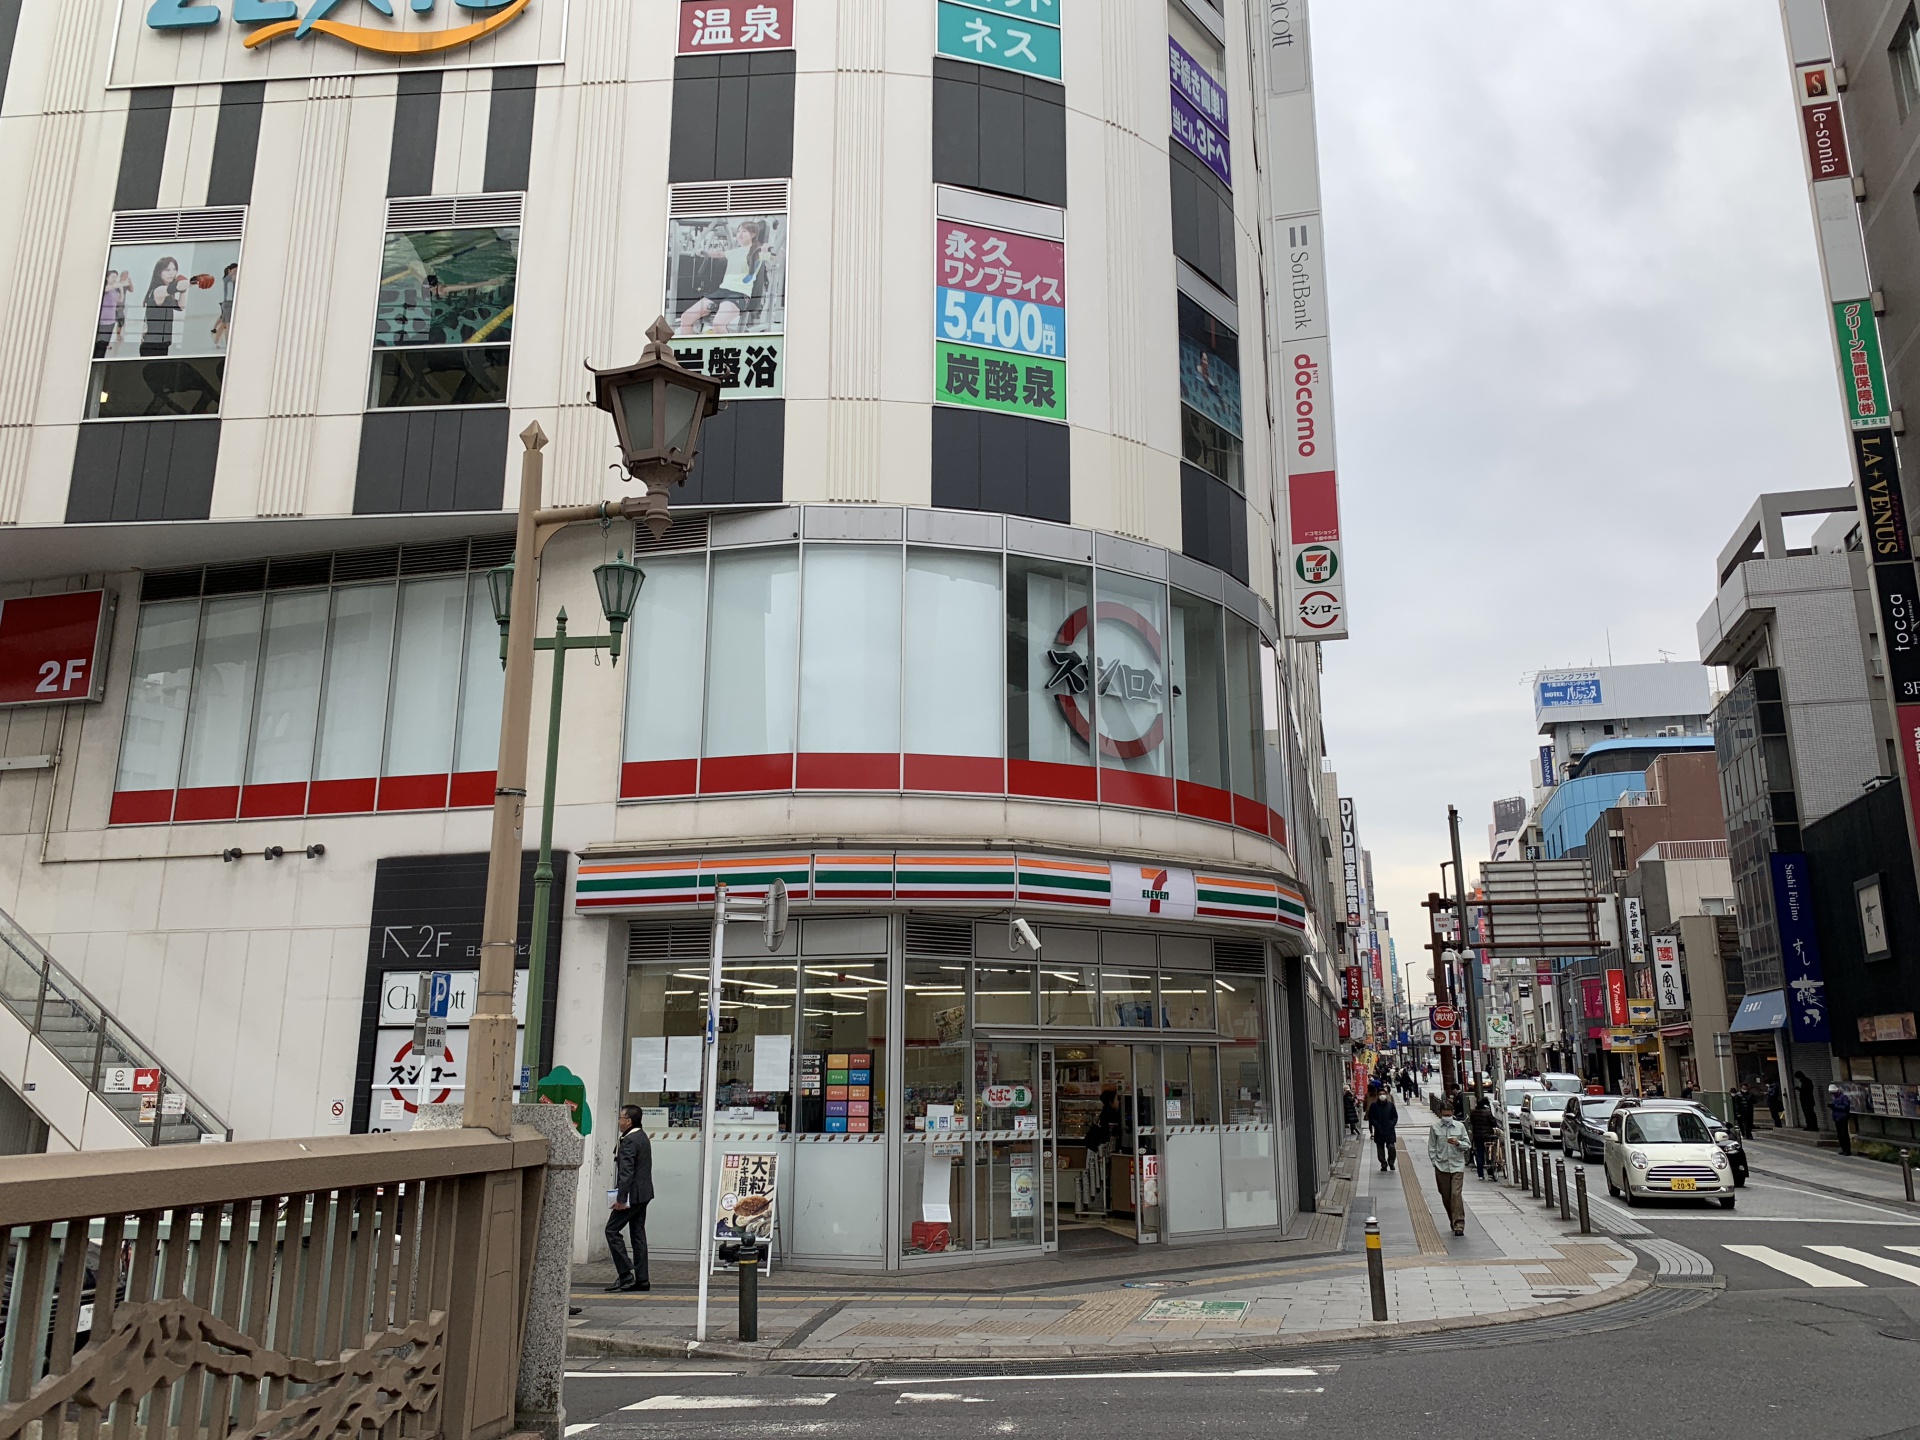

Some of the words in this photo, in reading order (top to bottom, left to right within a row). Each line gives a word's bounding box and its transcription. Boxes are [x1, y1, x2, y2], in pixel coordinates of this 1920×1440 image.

[691, 4, 782, 47] 温泉
[962, 18, 1038, 62] ネス
[1811, 74, 1822, 94] S
[1172, 105, 1229, 175] 当ビル3Fへ
[1812, 106, 1838, 174] le-sonia
[945, 230, 1012, 266] 永久
[944, 262, 1062, 304] ワンプライス
[1290, 252, 1313, 329] SoftBank
[945, 352, 1057, 409] 炭酸泉
[1294, 353, 1318, 457] docomo
[1861, 436, 1884, 468] LA
[1304, 528, 1337, 538] ドコモショップ
[1868, 479, 1898, 554] VENUS
[1298, 603, 1342, 616] スシロー
[1890, 593, 1911, 652] tocca
[35, 659, 87, 693] 2F
[1785, 863, 1797, 888] Sushi
[1788, 891, 1800, 921] Fujino
[416, 925, 452, 958] 2F
[434, 976, 448, 1013] P
[1434, 1013, 1454, 1022] 消火栓
[987, 1088, 1011, 1102] たばこ
[1015, 1088, 1026, 1102] 酒
[737, 1156, 750, 1197] カキ使用
[748, 1156, 768, 1195] 大粒
